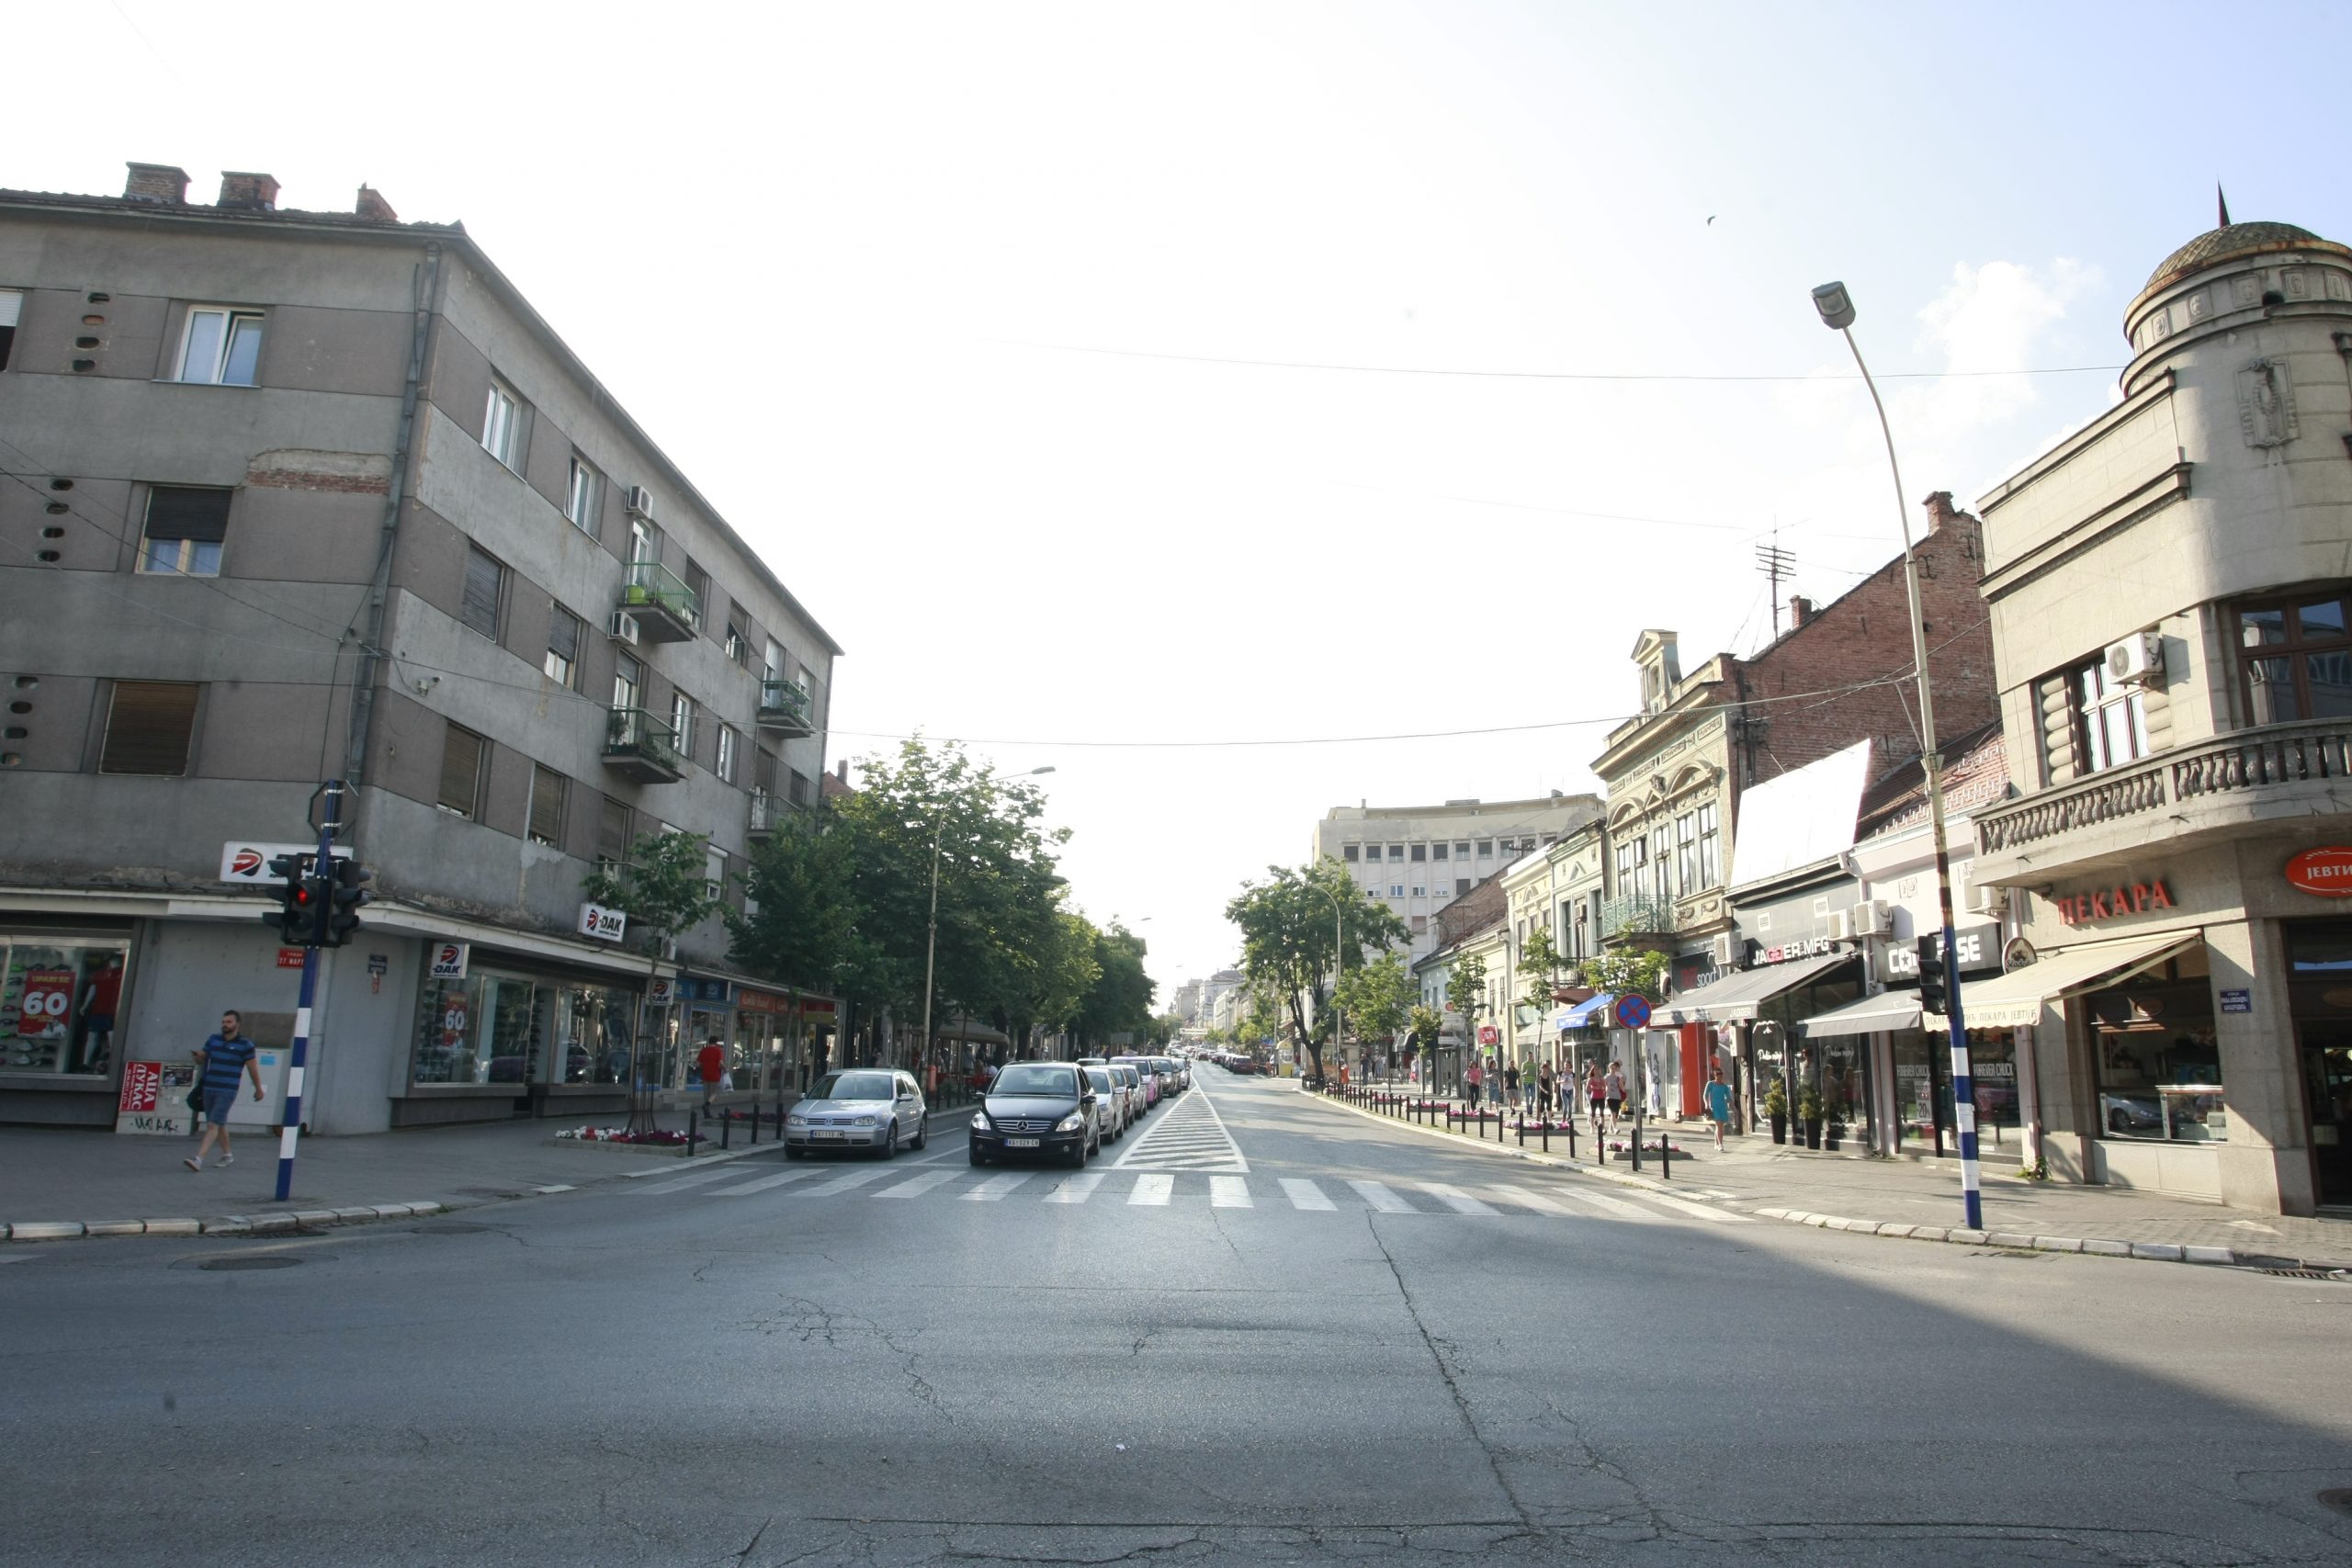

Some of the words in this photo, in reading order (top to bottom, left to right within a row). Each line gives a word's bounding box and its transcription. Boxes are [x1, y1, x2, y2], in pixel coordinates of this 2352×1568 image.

[2058, 881, 2172, 926] ПЕКАРА
[1889, 935, 1981, 973] COSE
[23, 991, 68, 1016] 60
[1980, 1011, 2007, 1021] ПЕКАРА
[446, 1010, 465, 1030] 60
